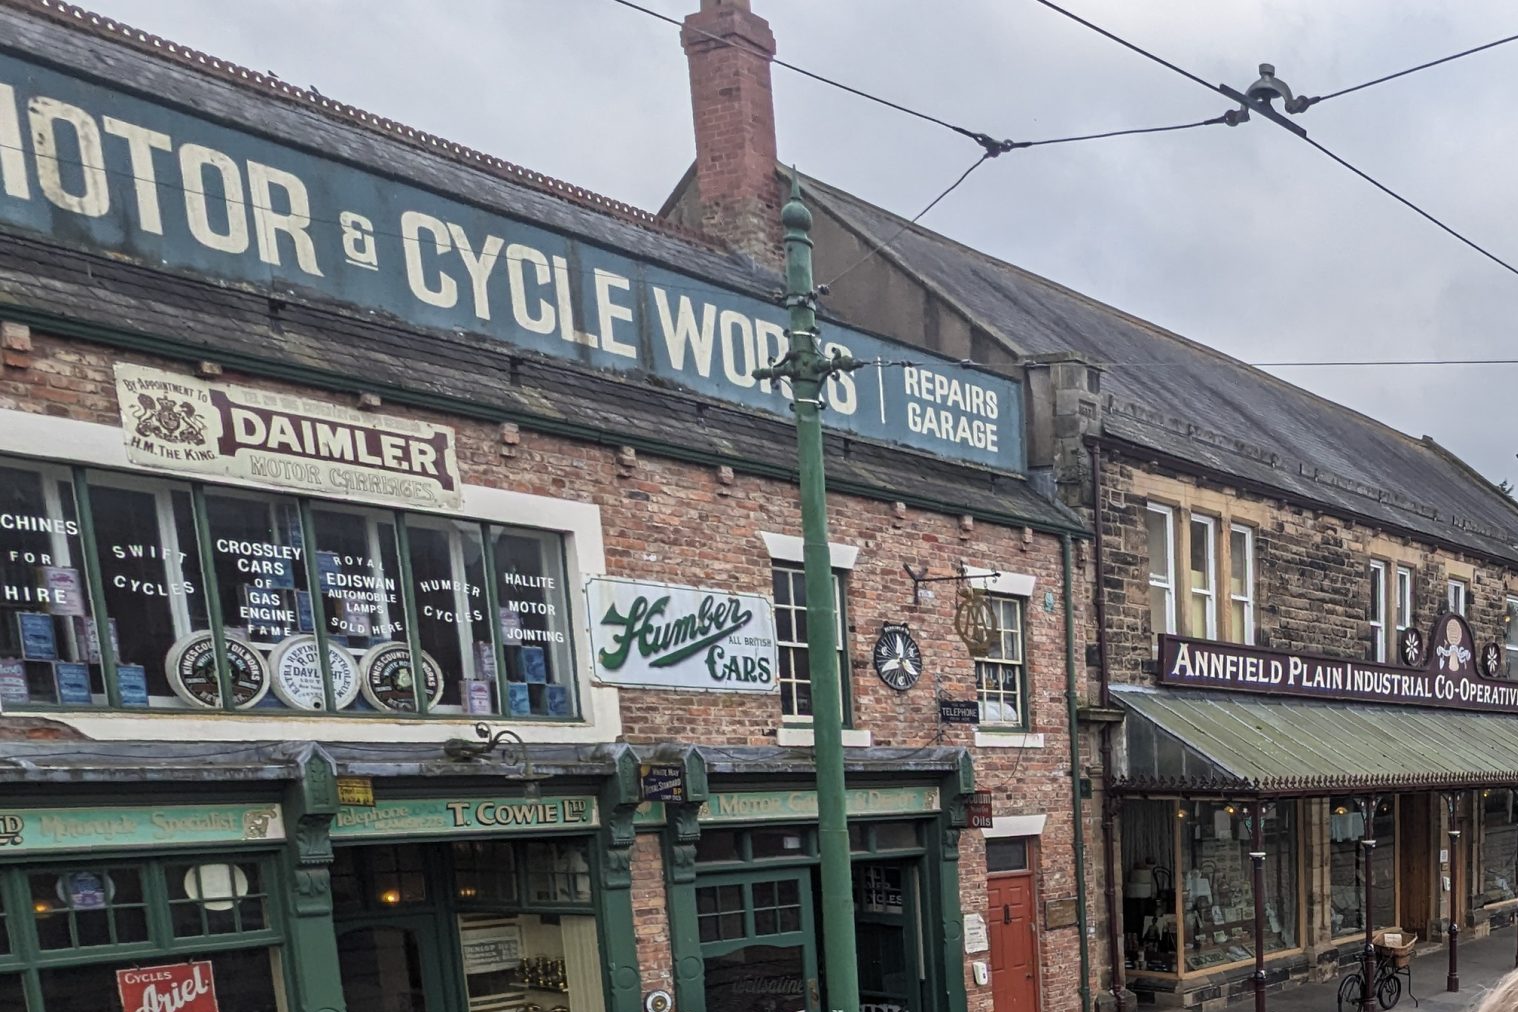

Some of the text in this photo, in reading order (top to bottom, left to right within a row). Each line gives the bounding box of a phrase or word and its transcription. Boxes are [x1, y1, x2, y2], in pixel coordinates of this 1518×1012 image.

[339, 211, 378, 271] &
[401, 210, 637, 360] CYCLE
[654, 287, 857, 416] WORS
[137, 377, 194, 398] APPOINTMENT
[197, 390, 208, 403] TO
[904, 366, 998, 420] REPAIRS
[907, 402, 998, 452] GARAGE
[131, 436, 157, 455] H.M.
[159, 445, 181, 460] THE
[230, 407, 439, 476] DAIMLER
[250, 455, 322, 485] MOTOR
[10, 551, 51, 564] FOR
[113, 544, 187, 564] SWIFT
[216, 539, 301, 560] CROSSLEY
[238, 559, 285, 576] CARS
[333, 556, 384, 571] ROYAL
[113, 575, 195, 596] CYCLES
[254, 579, 273, 589] OF
[326, 573, 395, 591] EDISWAN
[420, 579, 481, 597] HUMBER
[505, 573, 555, 589] HALLITE
[5, 585, 67, 604] HIRE
[250, 592, 281, 606] GAS
[328, 589, 396, 603] AUTOMOBILE
[240, 607, 296, 622] ENGINE
[346, 602, 384, 614] LAMPS
[424, 606, 483, 623] CYCLES
[509, 601, 556, 615] MOTOR
[249, 625, 292, 636] FAME
[331, 617, 403, 635] SOLD HERE
[599, 595, 752, 670] Humber
[507, 628, 564, 643] JOINTING
[729, 637, 741, 645] ALL
[705, 645, 771, 683] CARS
[1171, 642, 1283, 685] ANNFIELD
[1287, 656, 1342, 690] PLAIN
[1346, 663, 1432, 698] INDUSTRIAL
[293, 667, 342, 680] DAYLHT
[942, 708, 977, 717] TELEPHONE
[447, 802, 471, 826] T.
[476, 802, 557, 825] COWIE
[972, 816, 991, 826] Oils
[152, 811, 237, 839] Specialist
[125, 972, 172, 984] CYCLES
